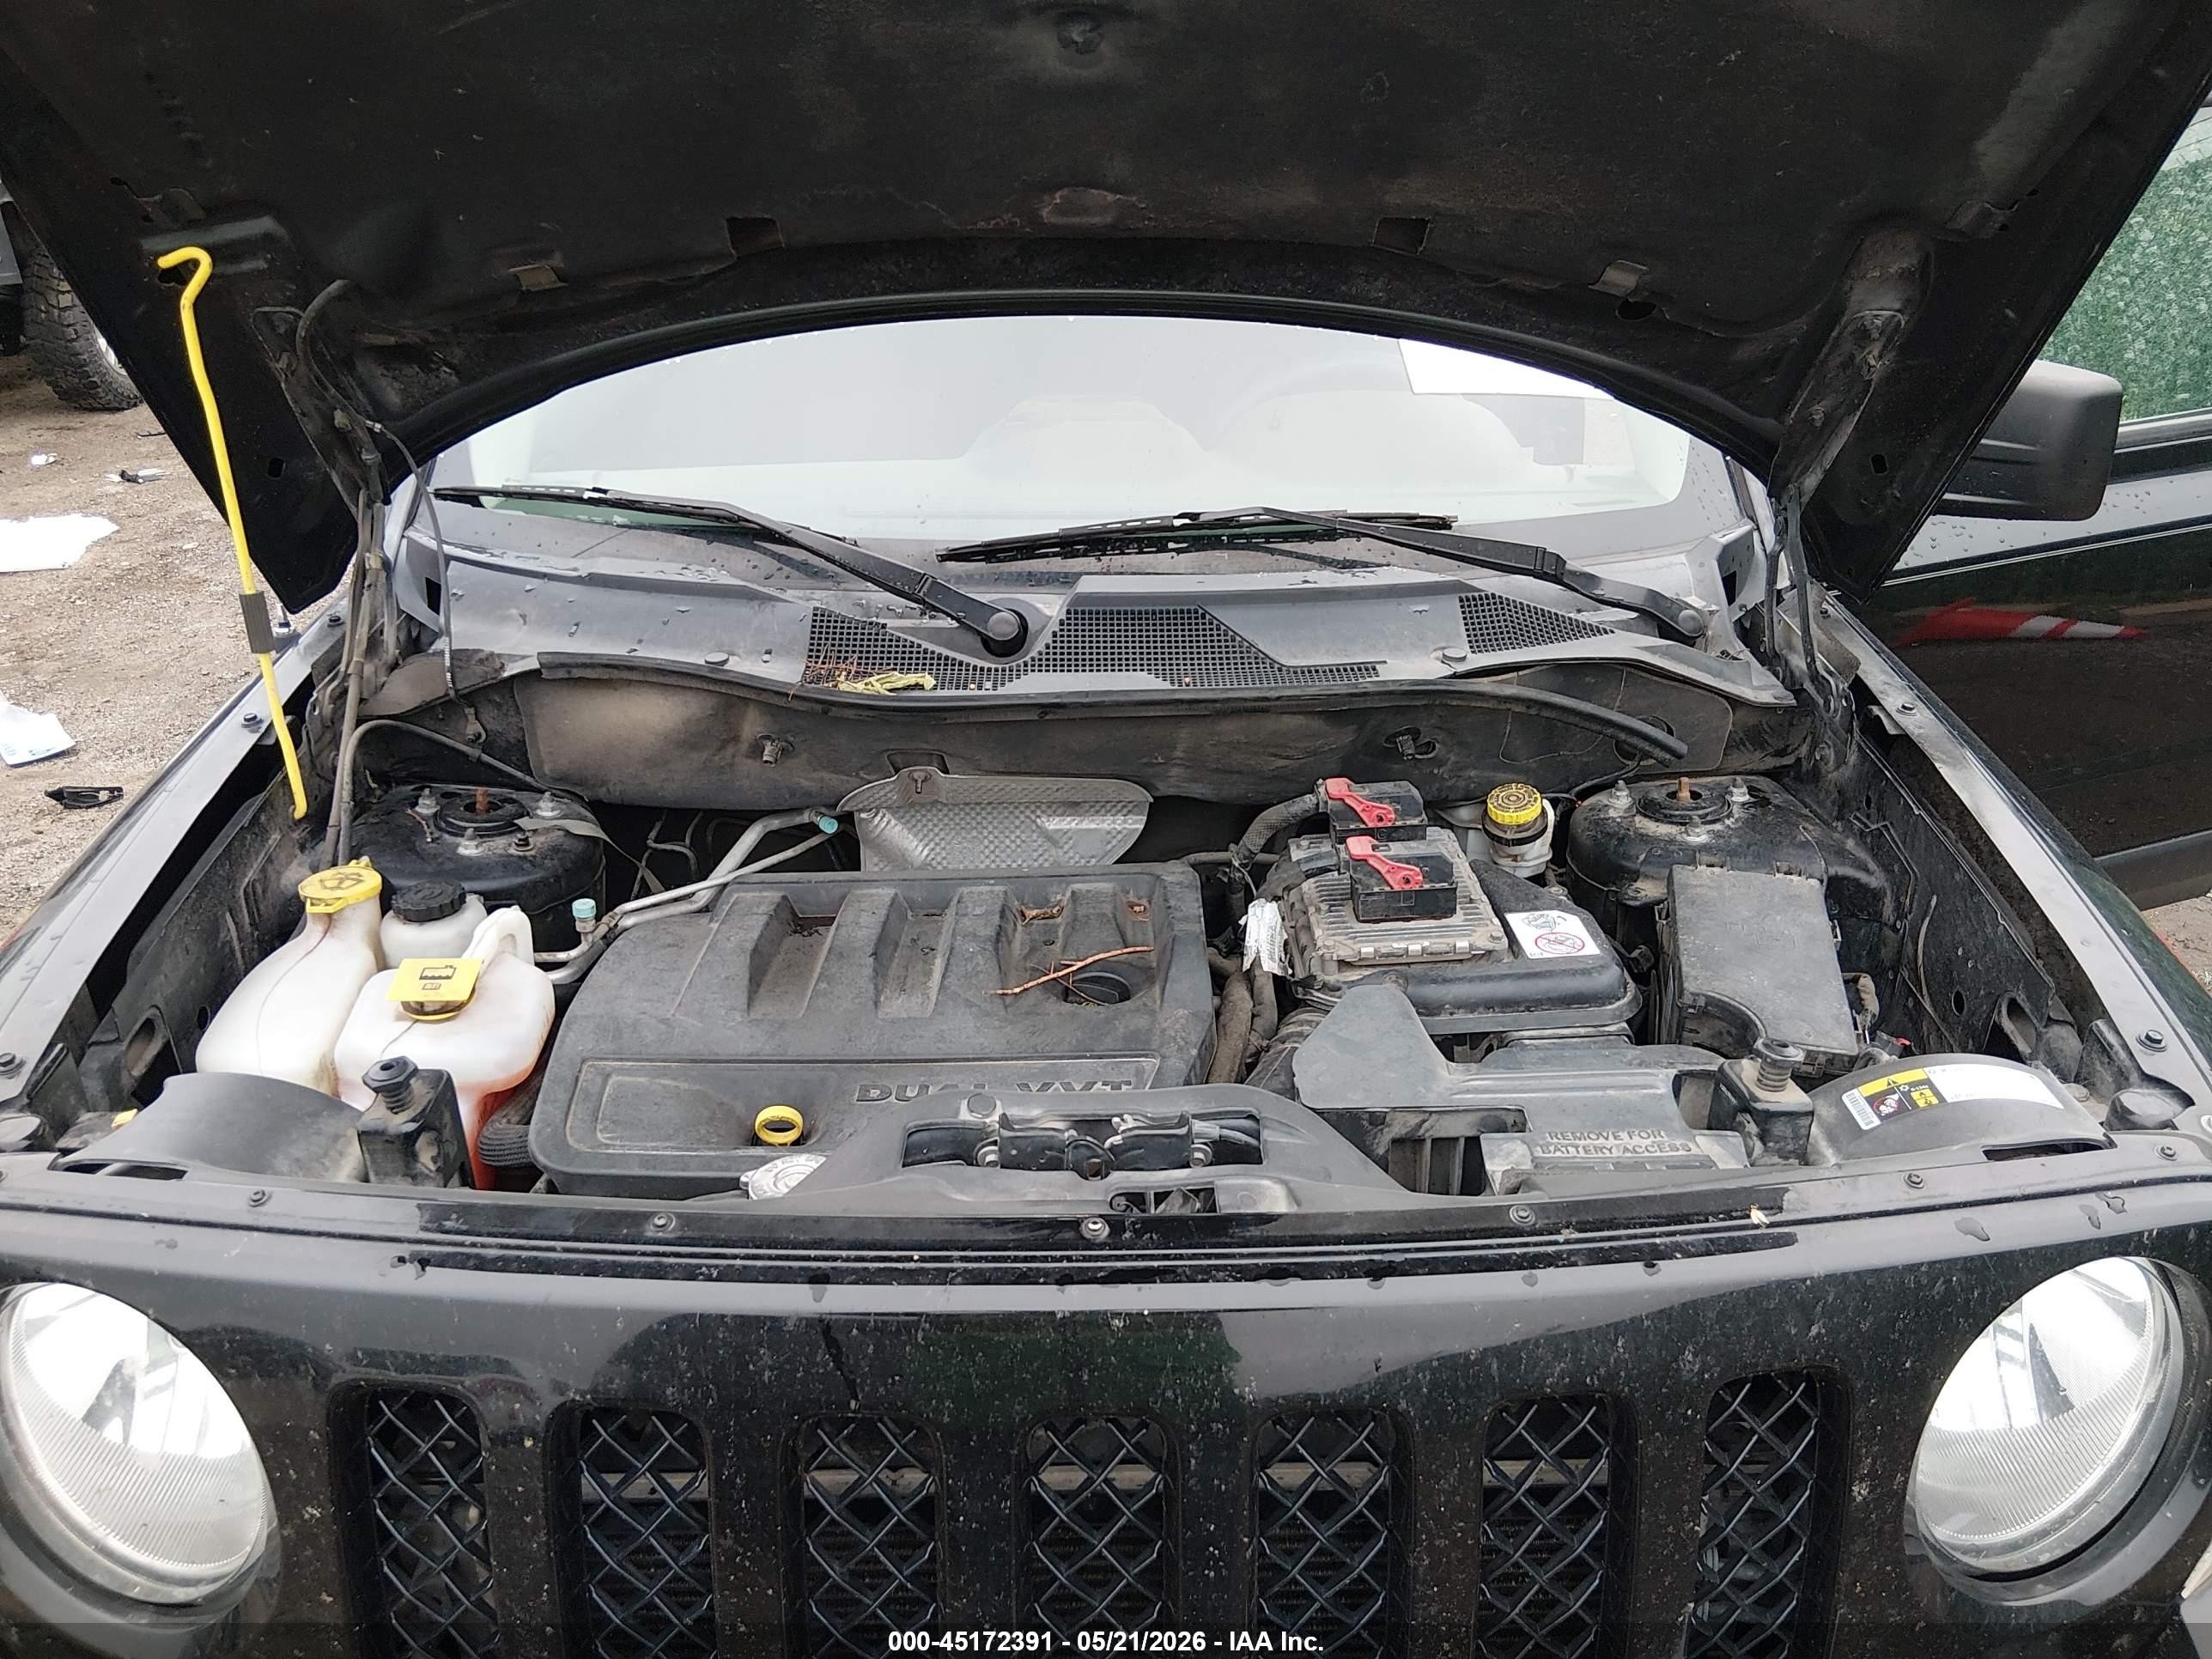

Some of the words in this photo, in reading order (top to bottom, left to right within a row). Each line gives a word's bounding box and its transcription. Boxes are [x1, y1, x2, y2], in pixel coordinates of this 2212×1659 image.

[1547, 1130, 1624, 1142] REMOVE
[1626, 1129, 1666, 1140] FOR
[1538, 1144, 1614, 1155] BATTERY
[1622, 1142, 1692, 1155] ACCESS
